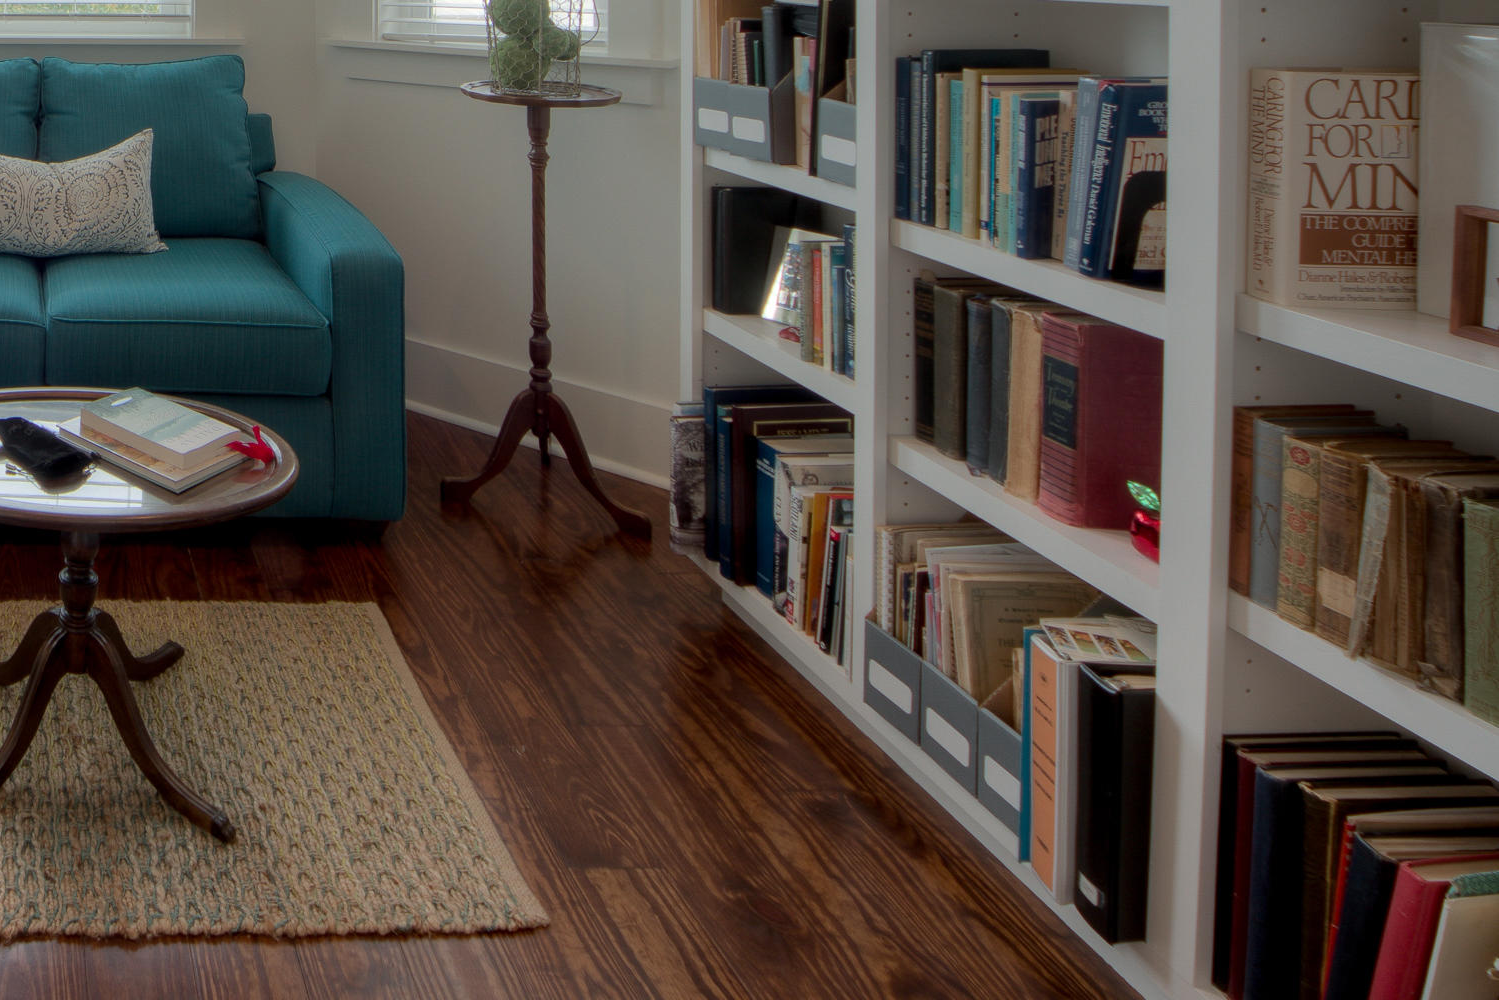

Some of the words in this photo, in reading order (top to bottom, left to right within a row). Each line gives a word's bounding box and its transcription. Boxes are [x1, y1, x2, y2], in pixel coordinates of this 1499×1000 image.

[1251, 85, 1267, 116] THE
[1262, 77, 1286, 144] CARING
[1097, 102, 1118, 143] Emotional
[1058, 131, 1069, 167] Teaching
[1251, 118, 1266, 164] MIND
[1304, 123, 1379, 159] FOR
[1263, 144, 1283, 176] FOR
[1086, 184, 1101, 208] Daniel
[1081, 209, 1098, 246] Goleman
[1304, 215, 1340, 231] THE
[1351, 233, 1406, 248] GUIDE
[1321, 249, 1391, 265] MENTAL
[1298, 269, 1335, 283] Dianne
[1338, 270, 1367, 283] Hales
